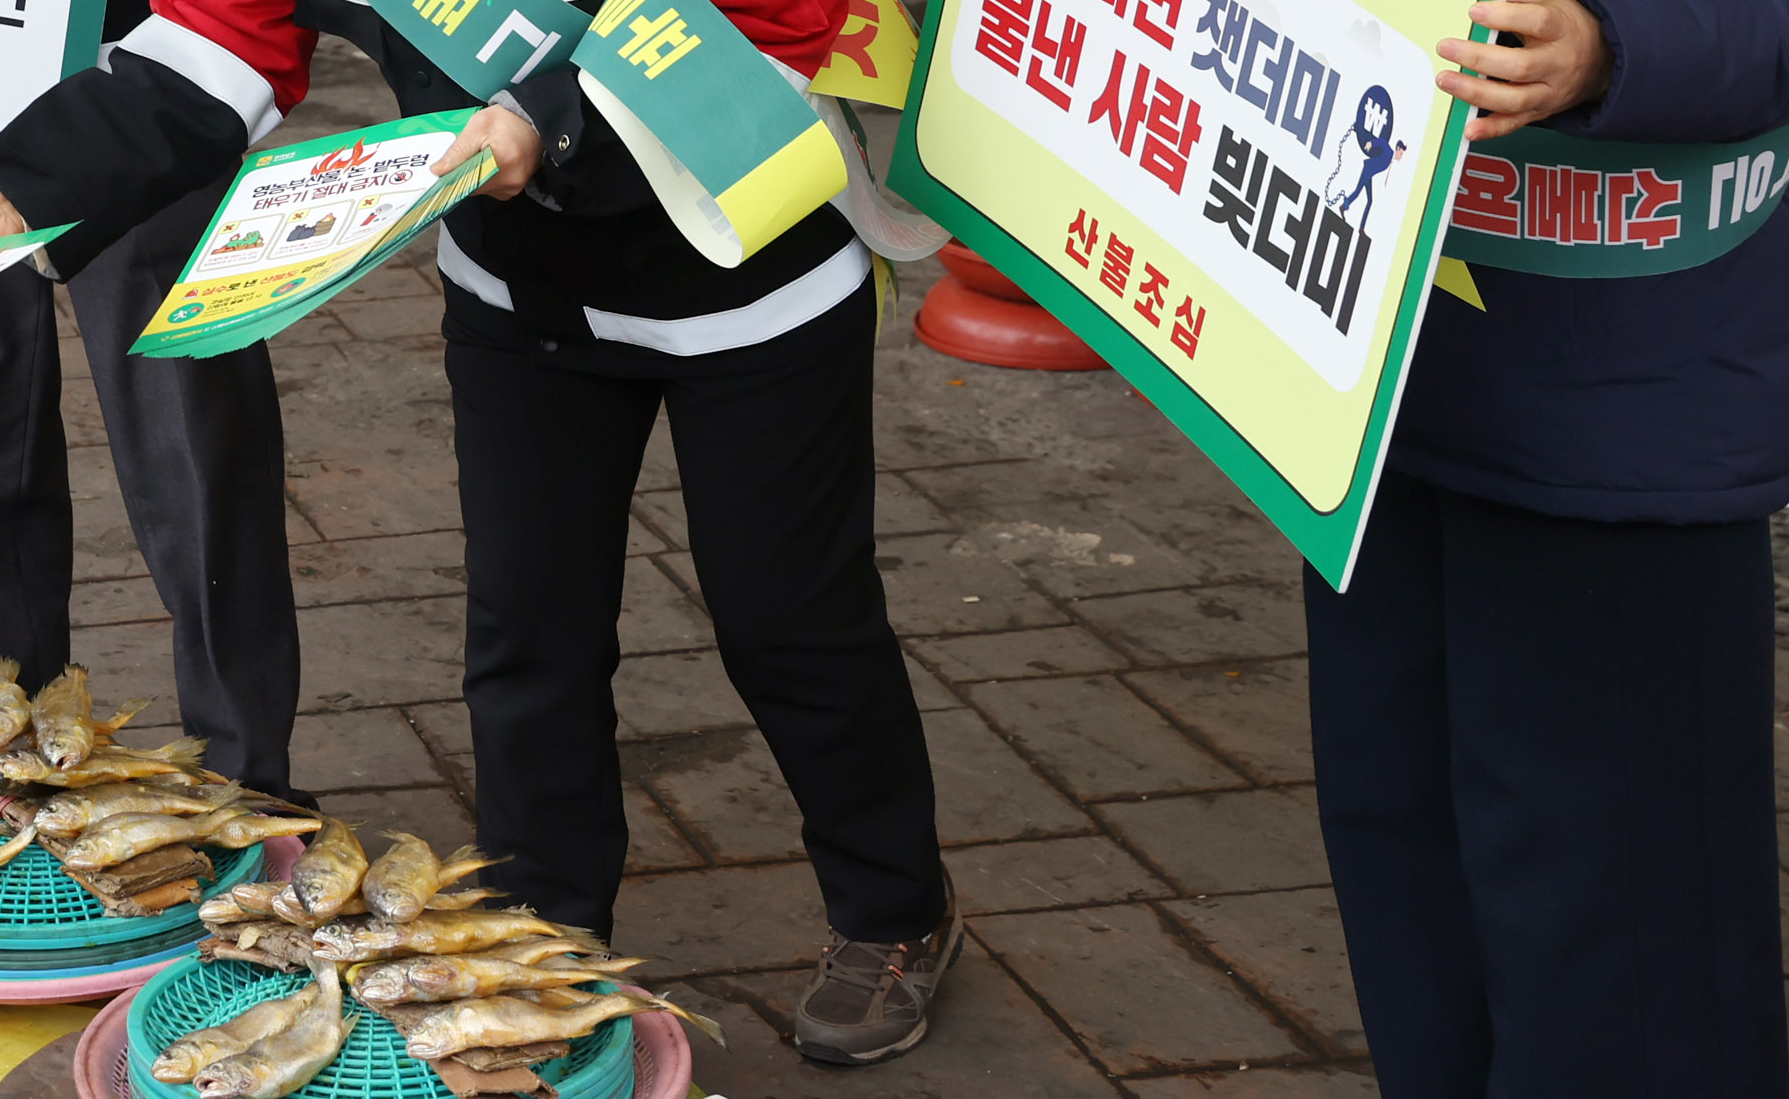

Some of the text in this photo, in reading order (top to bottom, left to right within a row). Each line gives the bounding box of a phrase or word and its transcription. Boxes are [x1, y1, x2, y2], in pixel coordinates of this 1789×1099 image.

[253, 173, 387, 211] 태우기 절대 금지
[1087, 49, 1202, 196] 사람
[1203, 124, 1372, 337] 빚더미
